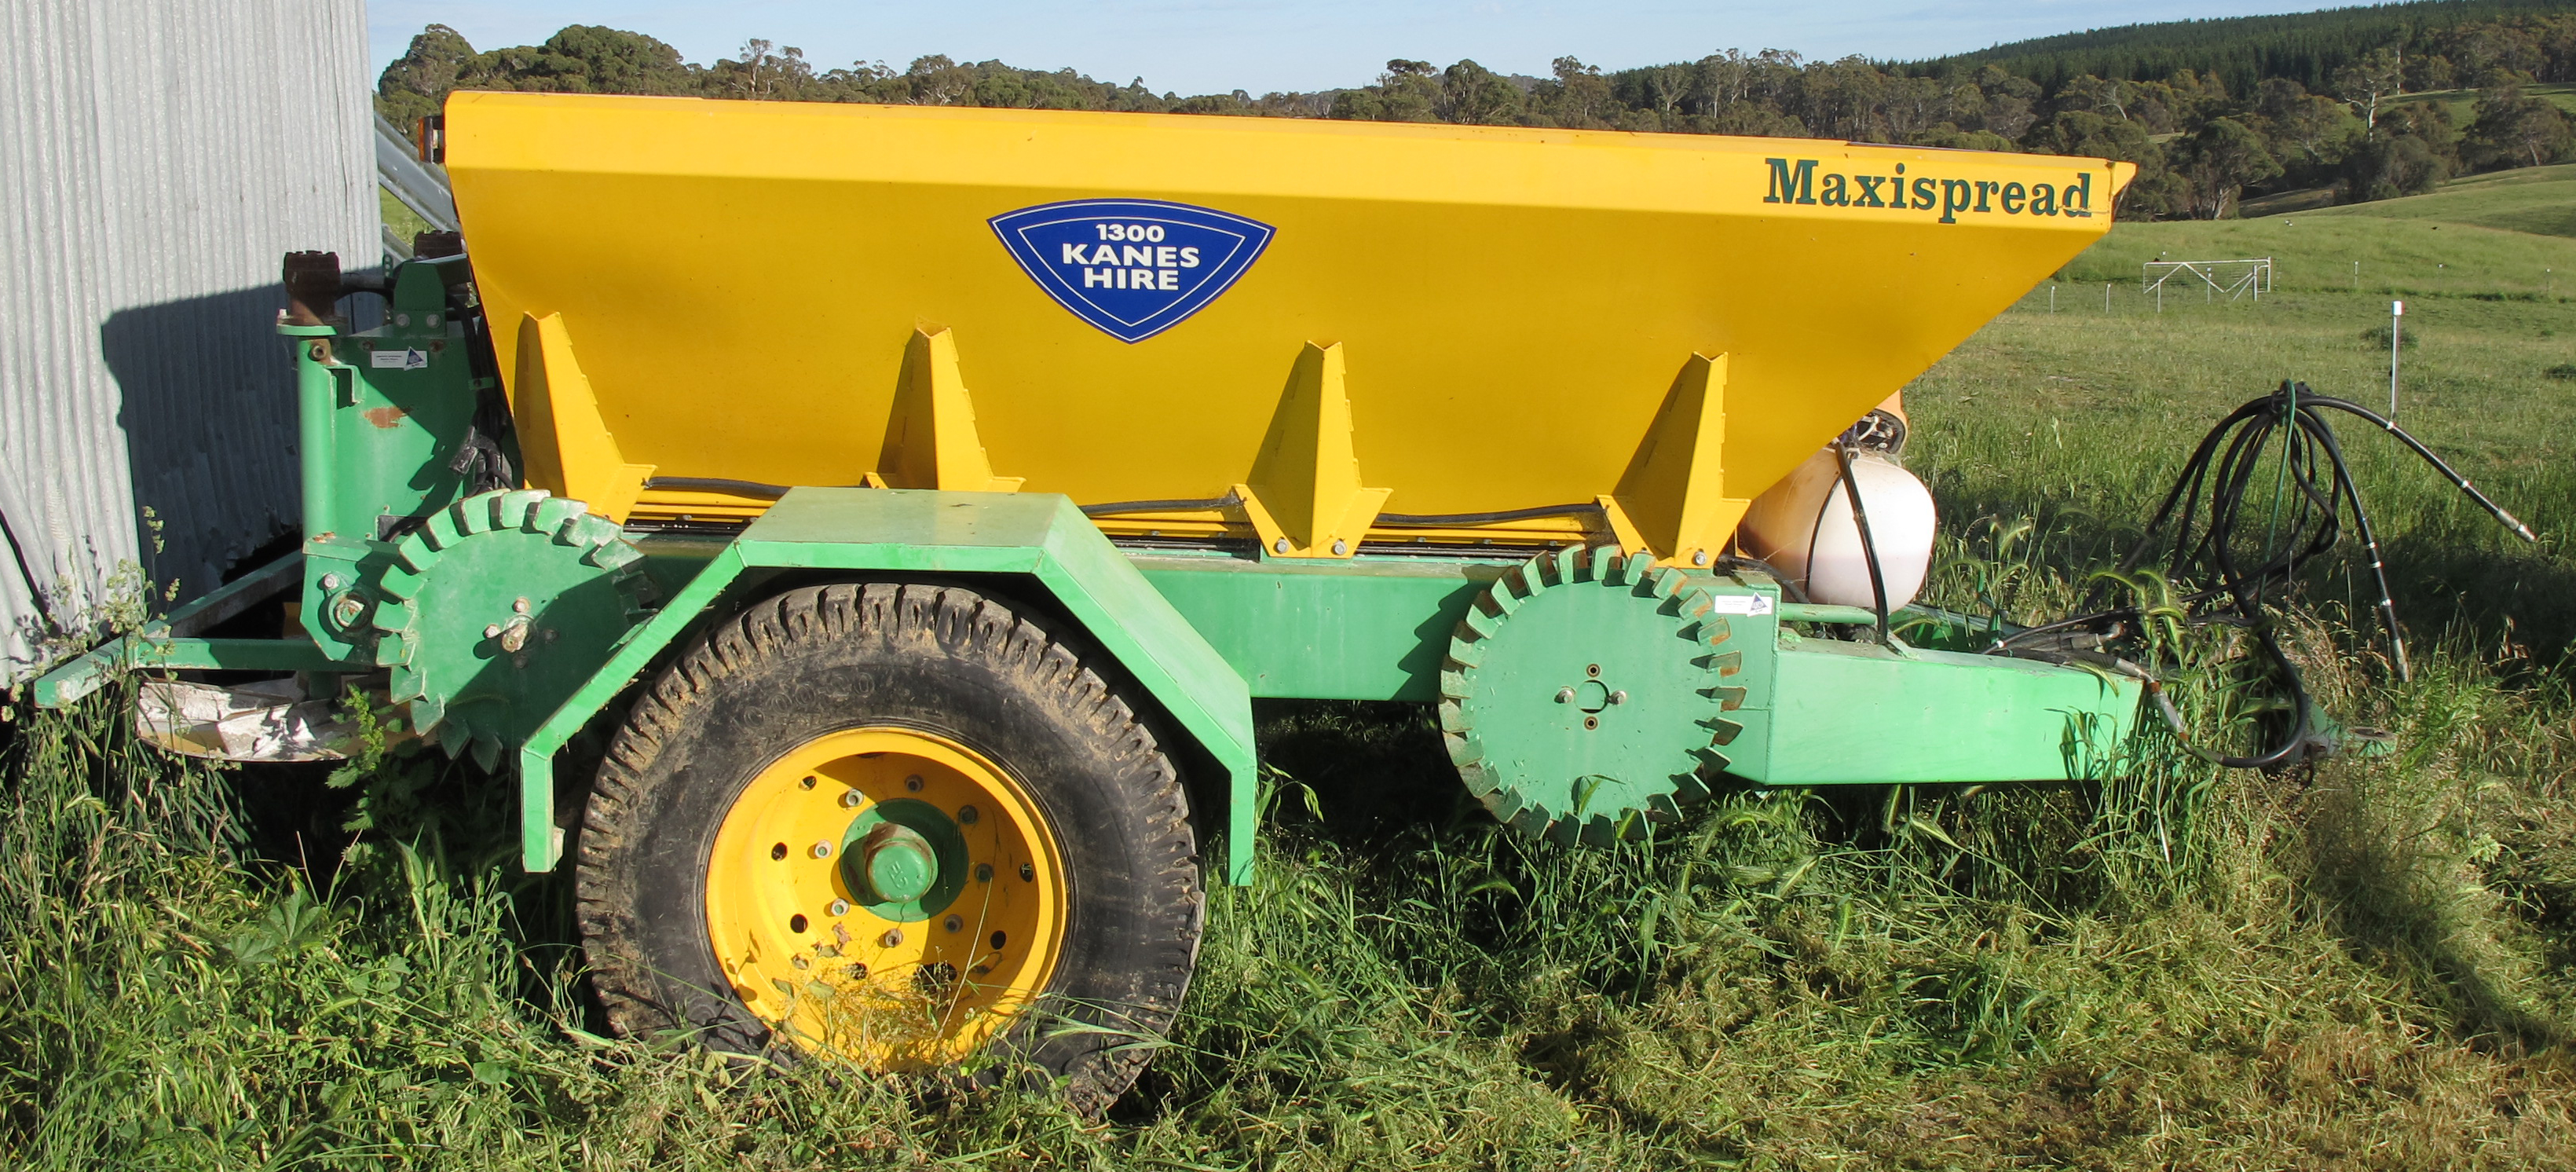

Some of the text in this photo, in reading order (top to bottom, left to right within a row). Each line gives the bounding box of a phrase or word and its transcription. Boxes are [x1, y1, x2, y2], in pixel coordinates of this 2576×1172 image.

[1762, 157, 2092, 224] Maxispread
[1096, 223, 1165, 243] 1300
[1063, 243, 1200, 268] KANES
[1084, 267, 1179, 291] HIRE
